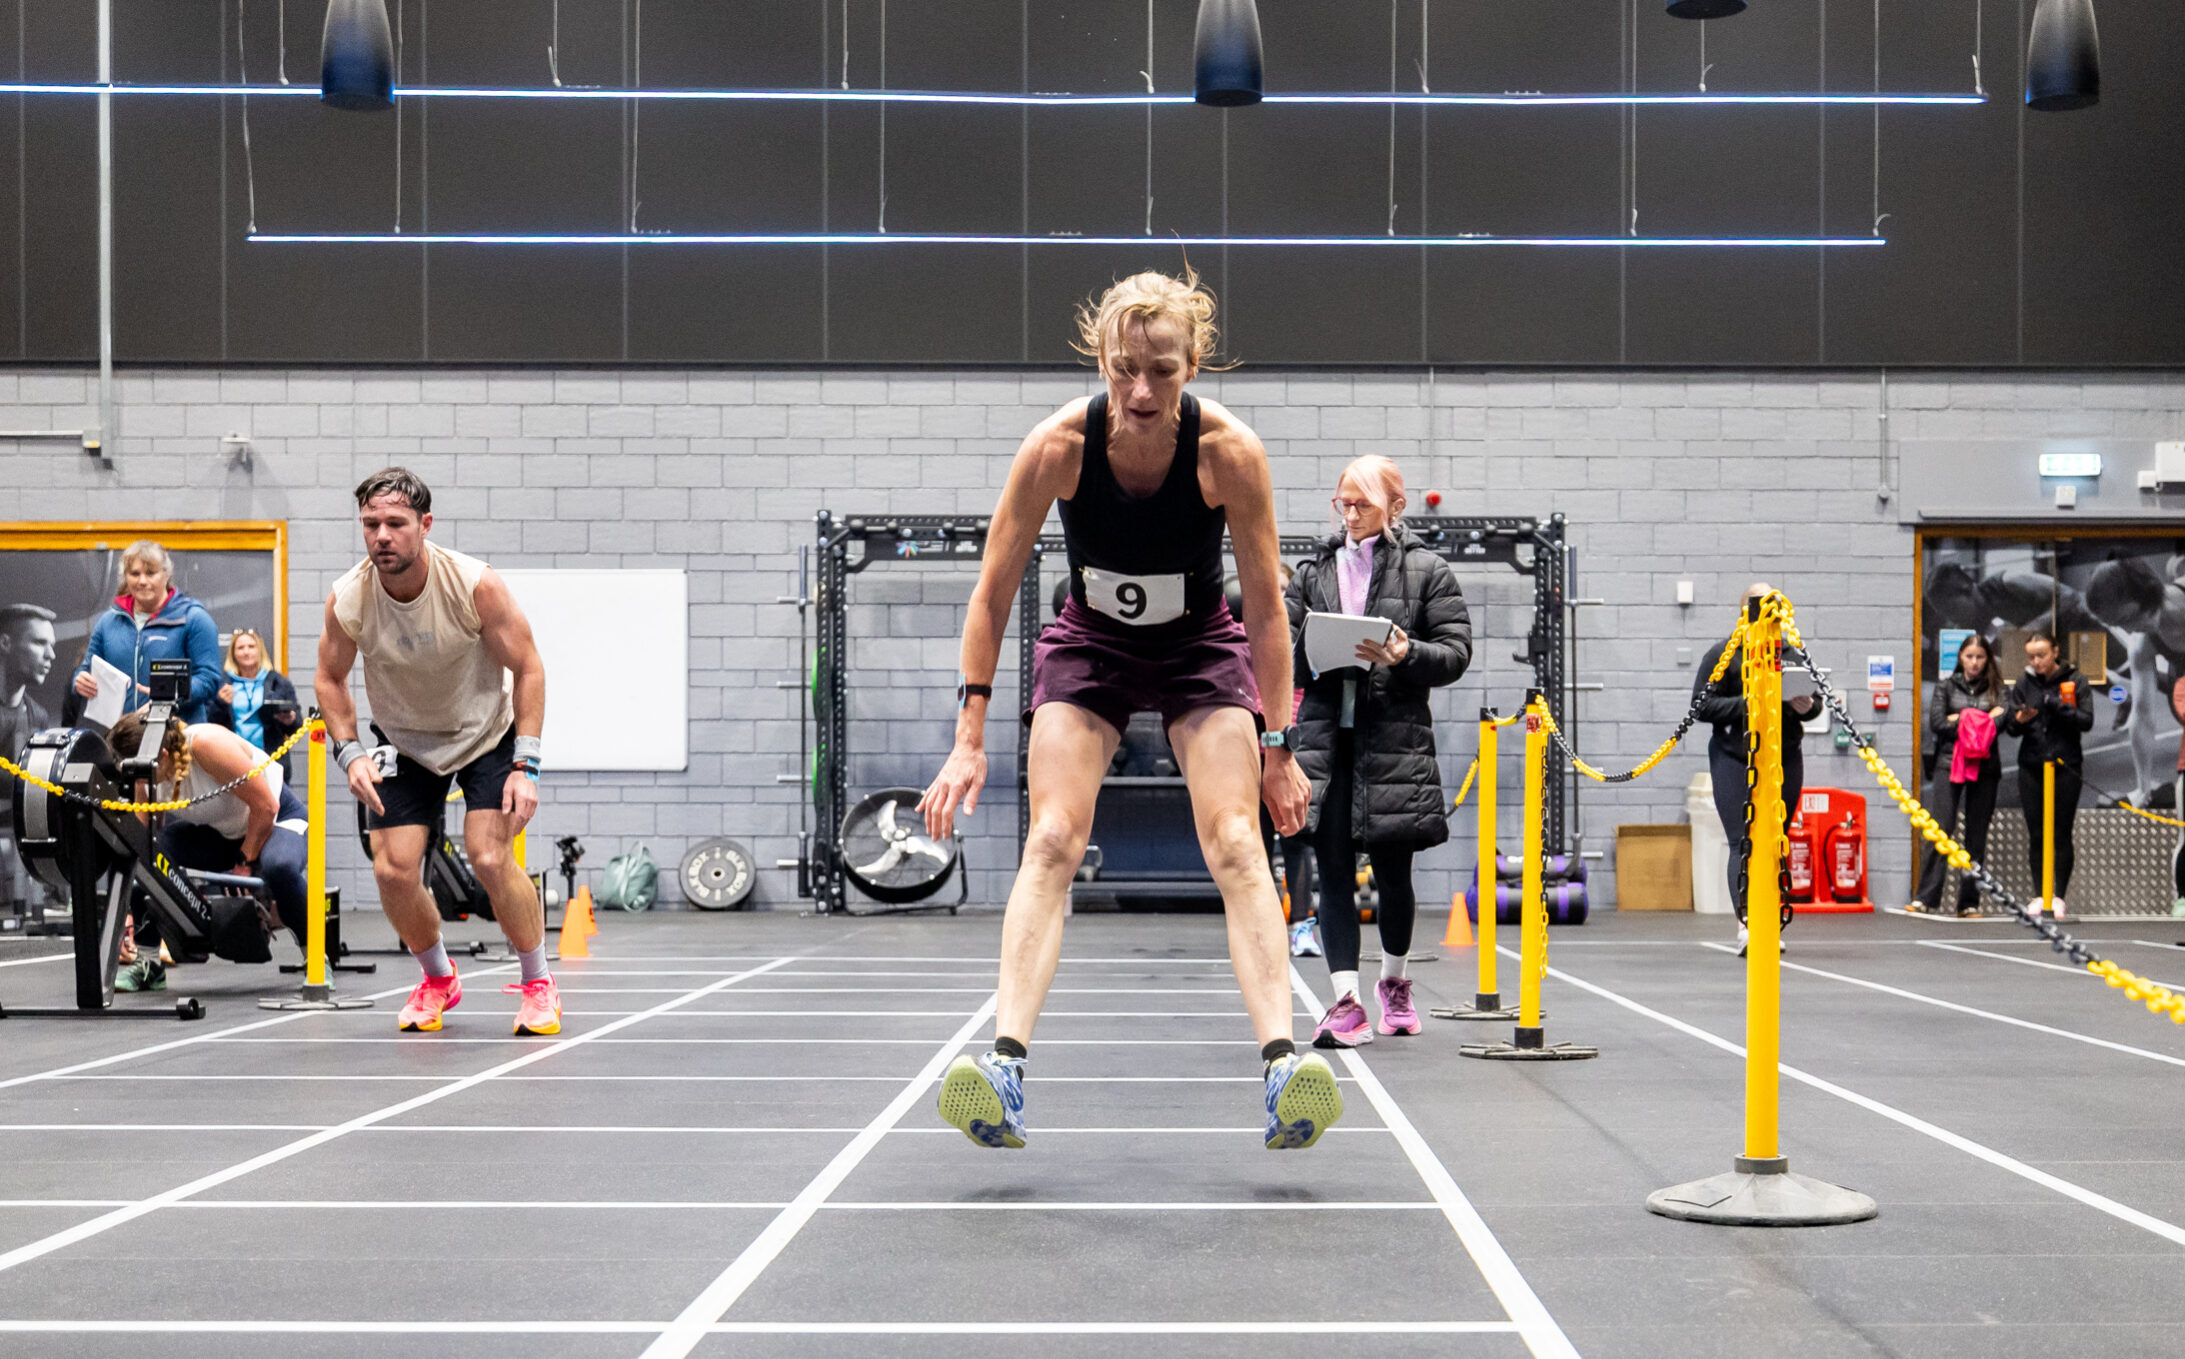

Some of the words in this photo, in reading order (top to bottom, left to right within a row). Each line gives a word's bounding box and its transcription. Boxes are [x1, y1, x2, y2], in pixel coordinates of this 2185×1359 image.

[1115, 582, 1147, 619] 9
[168, 868, 201, 913] concept
[201, 904, 207, 920] 2
